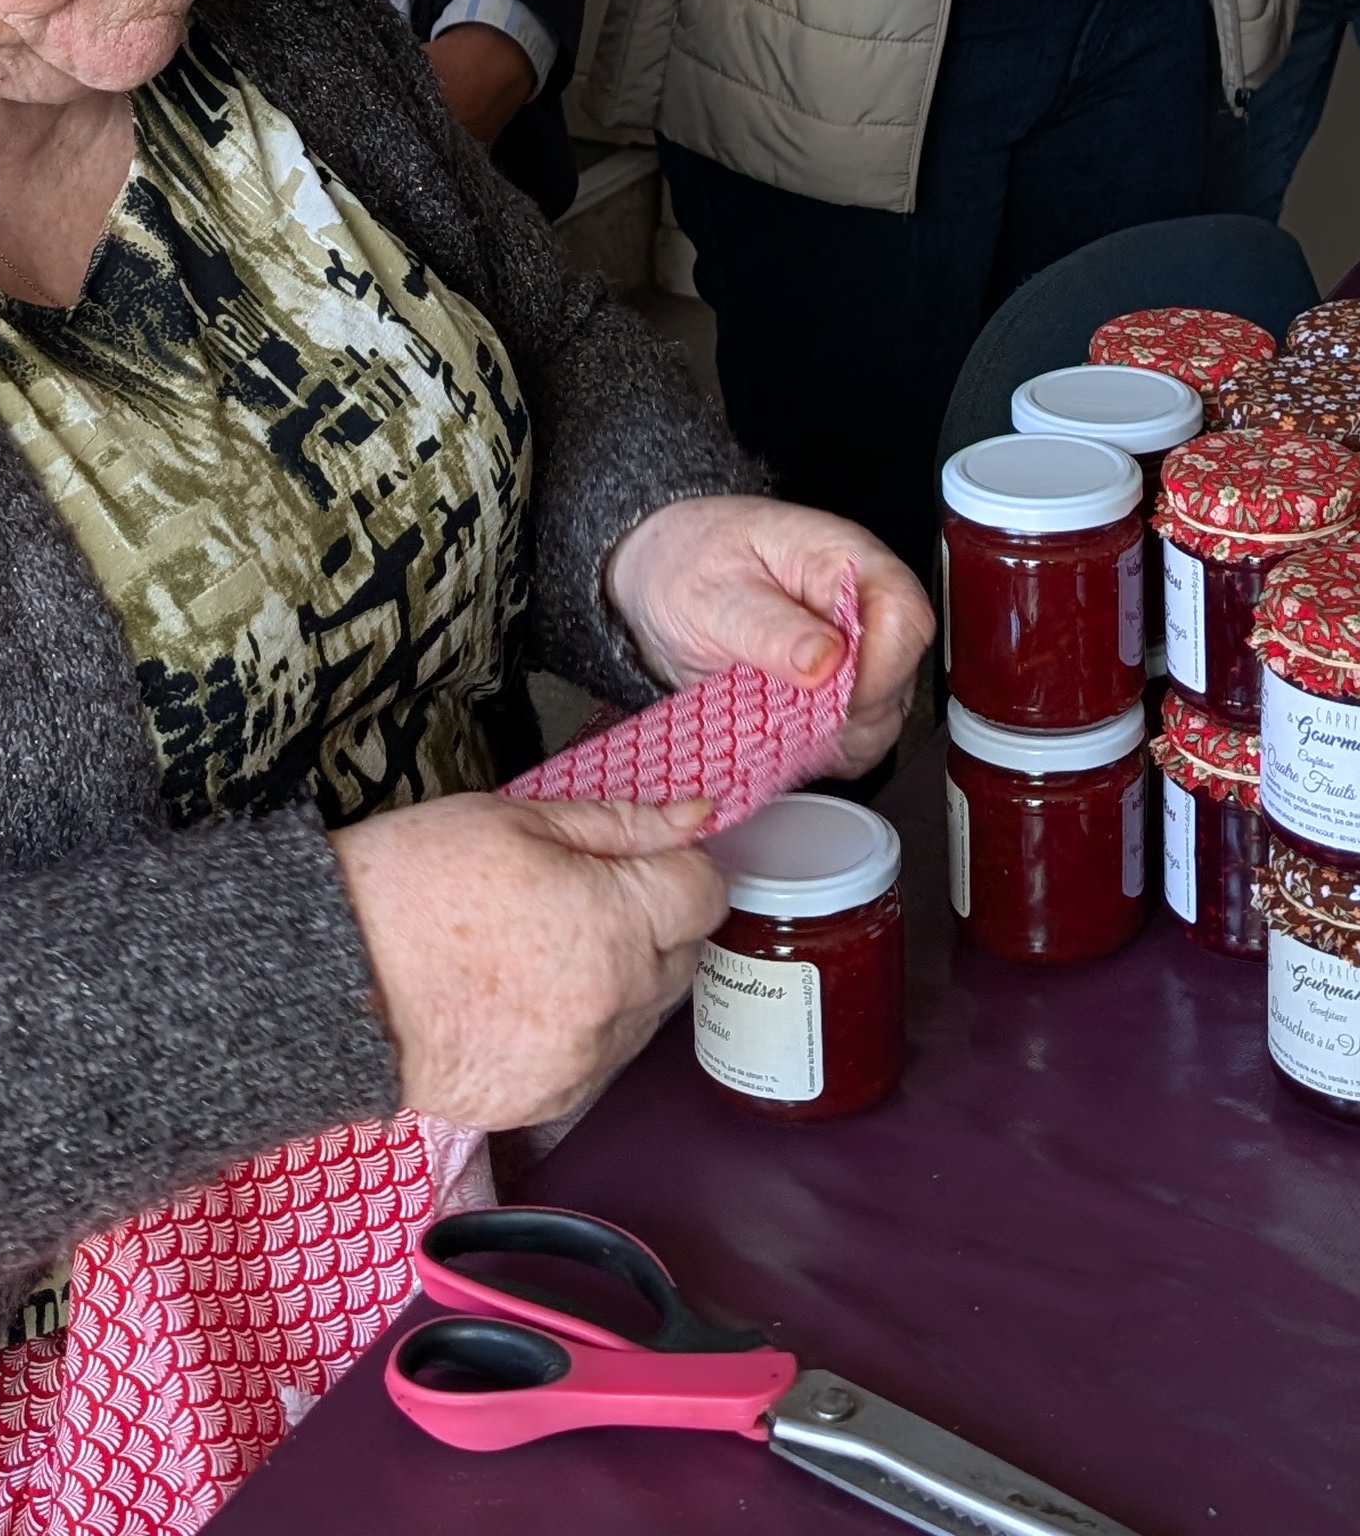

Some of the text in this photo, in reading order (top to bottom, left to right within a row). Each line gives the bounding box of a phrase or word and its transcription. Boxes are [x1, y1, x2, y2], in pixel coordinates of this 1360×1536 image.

[1286, 712, 1294, 724] &
[1297, 748, 1335, 770] Confiture
[1267, 742, 1300, 784] Quatre
[1302, 770, 1358, 801] Fruits
[1345, 819, 1354, 828] de
[706, 946, 754, 977] APRICES
[696, 961, 788, 1000] ourmandises
[1307, 999, 1348, 1024] Confiture
[696, 1005, 732, 1042] Fraise
[1316, 1034, 1323, 1047] à
[1325, 1036, 1335, 1051] la
[1328, 1072, 1349, 1086] vanille
